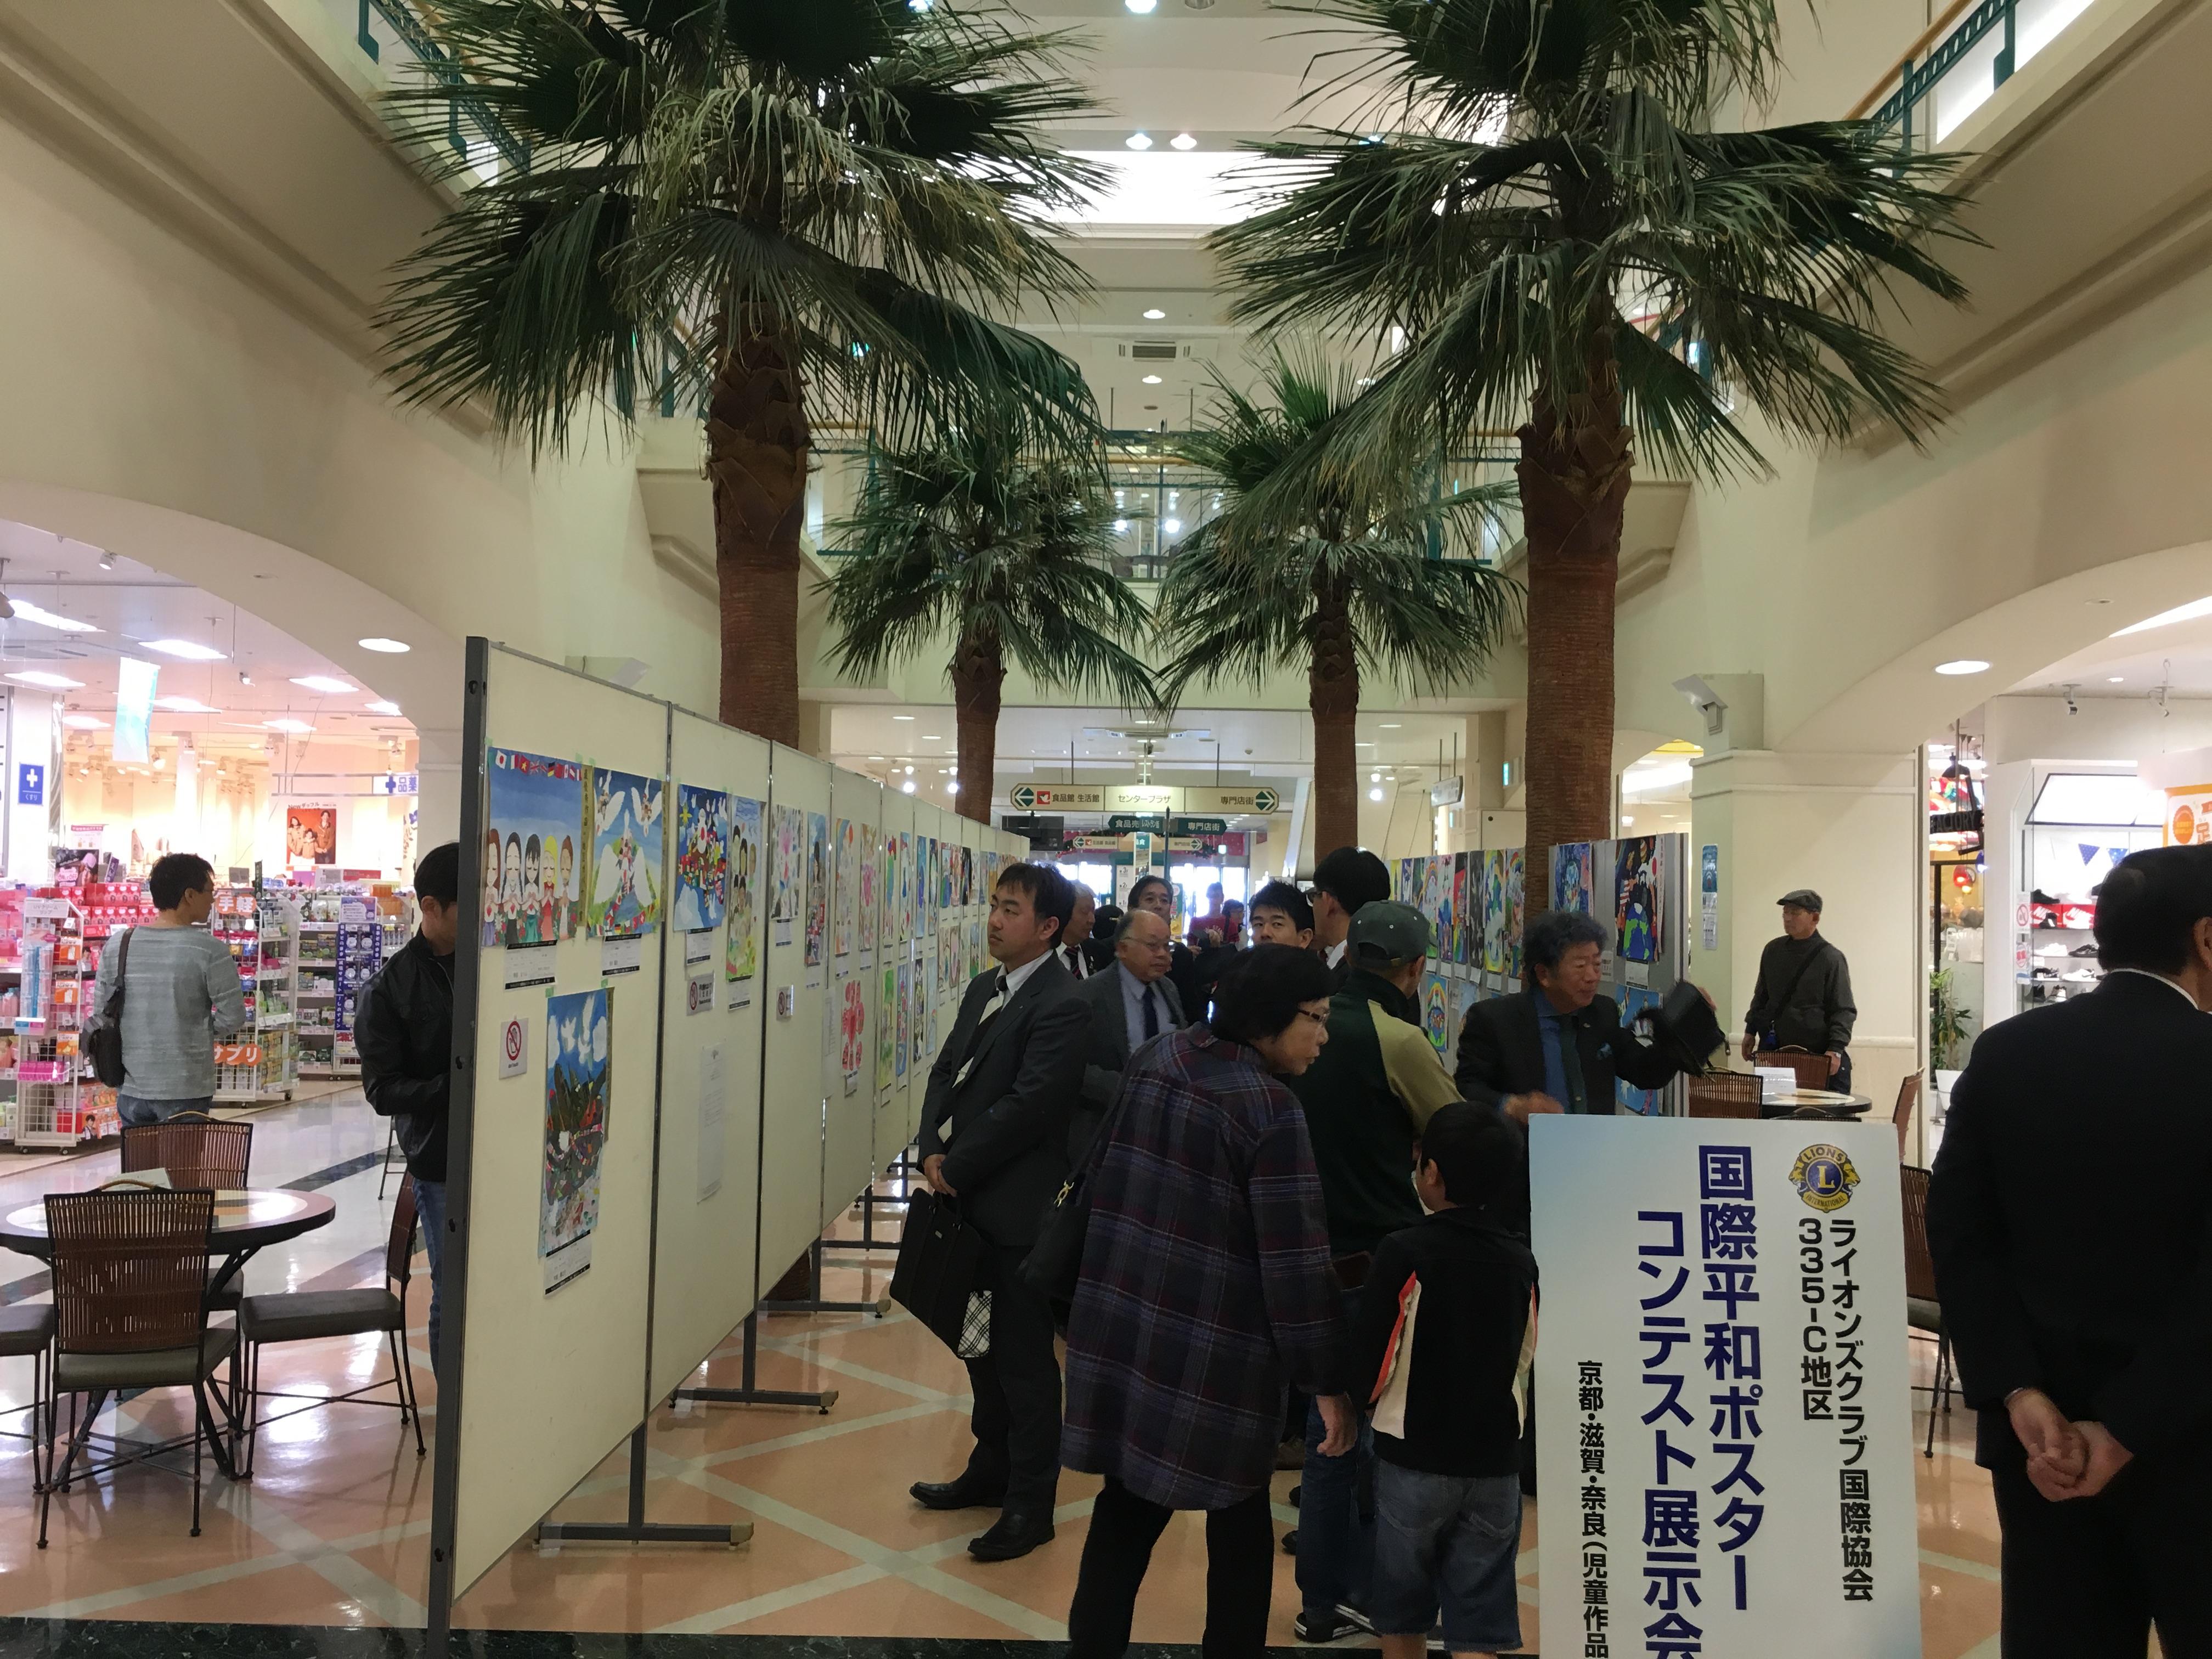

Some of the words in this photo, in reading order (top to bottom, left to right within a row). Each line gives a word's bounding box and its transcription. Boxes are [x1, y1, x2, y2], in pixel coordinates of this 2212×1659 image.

[1052, 793, 1075, 803] 食品館
[1077, 793, 1100, 803] 生活館
[1118, 794, 1171, 804] センタープラザ
[1220, 795, 1254, 805] 専門店街
[1187, 822, 1220, 831] 専門店街
[1803, 1147, 1844, 1162] LIONS
[1816, 1165, 1836, 1188] L
[1805, 1194, 1846, 1207] INTERNATIONAL
[1698, 1145, 1765, 1611] 国際平和ポスター
[1637, 1210, 1704, 1659] コンテスト展示会
